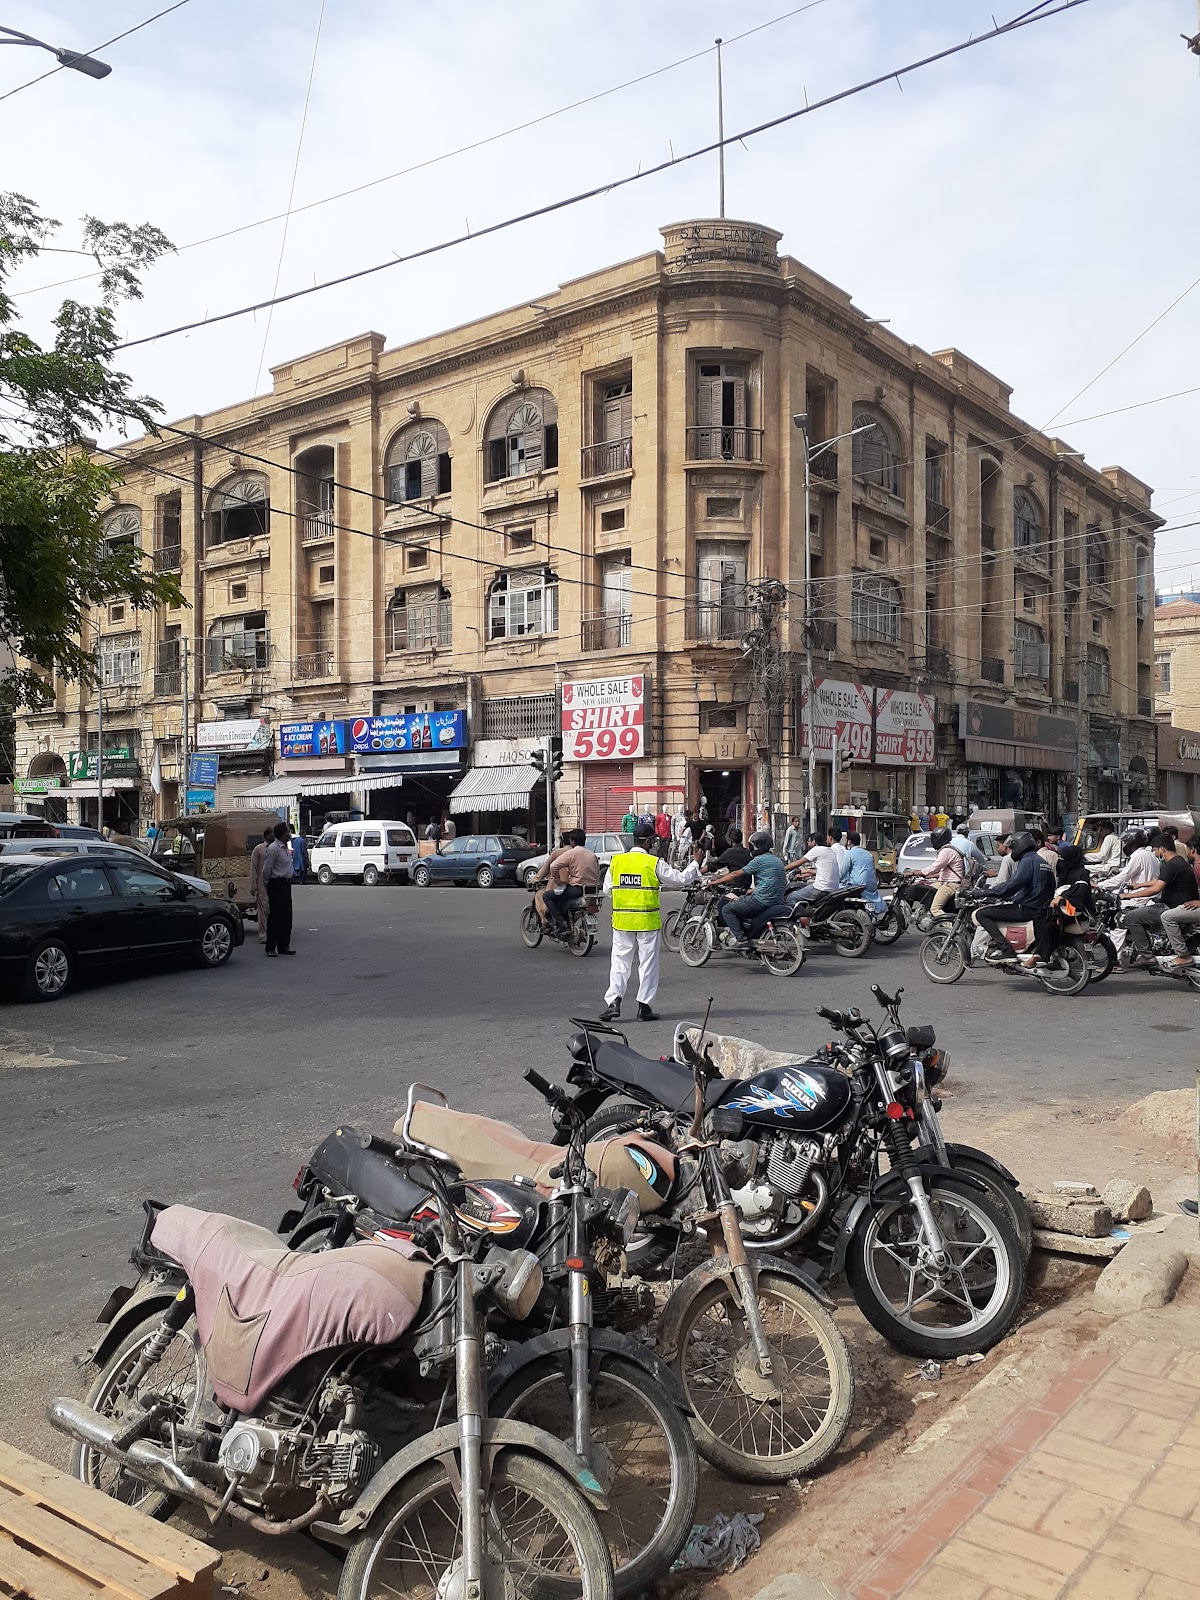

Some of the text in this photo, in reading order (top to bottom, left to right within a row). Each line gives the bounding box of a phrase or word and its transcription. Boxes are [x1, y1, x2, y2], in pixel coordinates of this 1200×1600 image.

[577, 681, 628, 697] WHOLE SALE
[583, 696, 622, 706] NEW ARRIVAL
[820, 689, 842, 707] WHOLE
[843, 693, 858, 709] SALE
[571, 704, 640, 730] SHIRT
[822, 707, 855, 720] NEW ARRIVAL
[891, 701, 922, 717] WHOLE SALE
[892, 717, 901, 726] NEW
[232, 730, 252, 741] Developers
[282, 726, 299, 734] QUETTA
[564, 727, 640, 759] Rs. 599
[838, 722, 872, 759] 499
[876, 730, 934, 762] SHIRT 599
[499, 749, 531, 763] HAQSO
[621, 875, 641, 885] POLICE
[781, 1077, 817, 1110] SUZUKI
